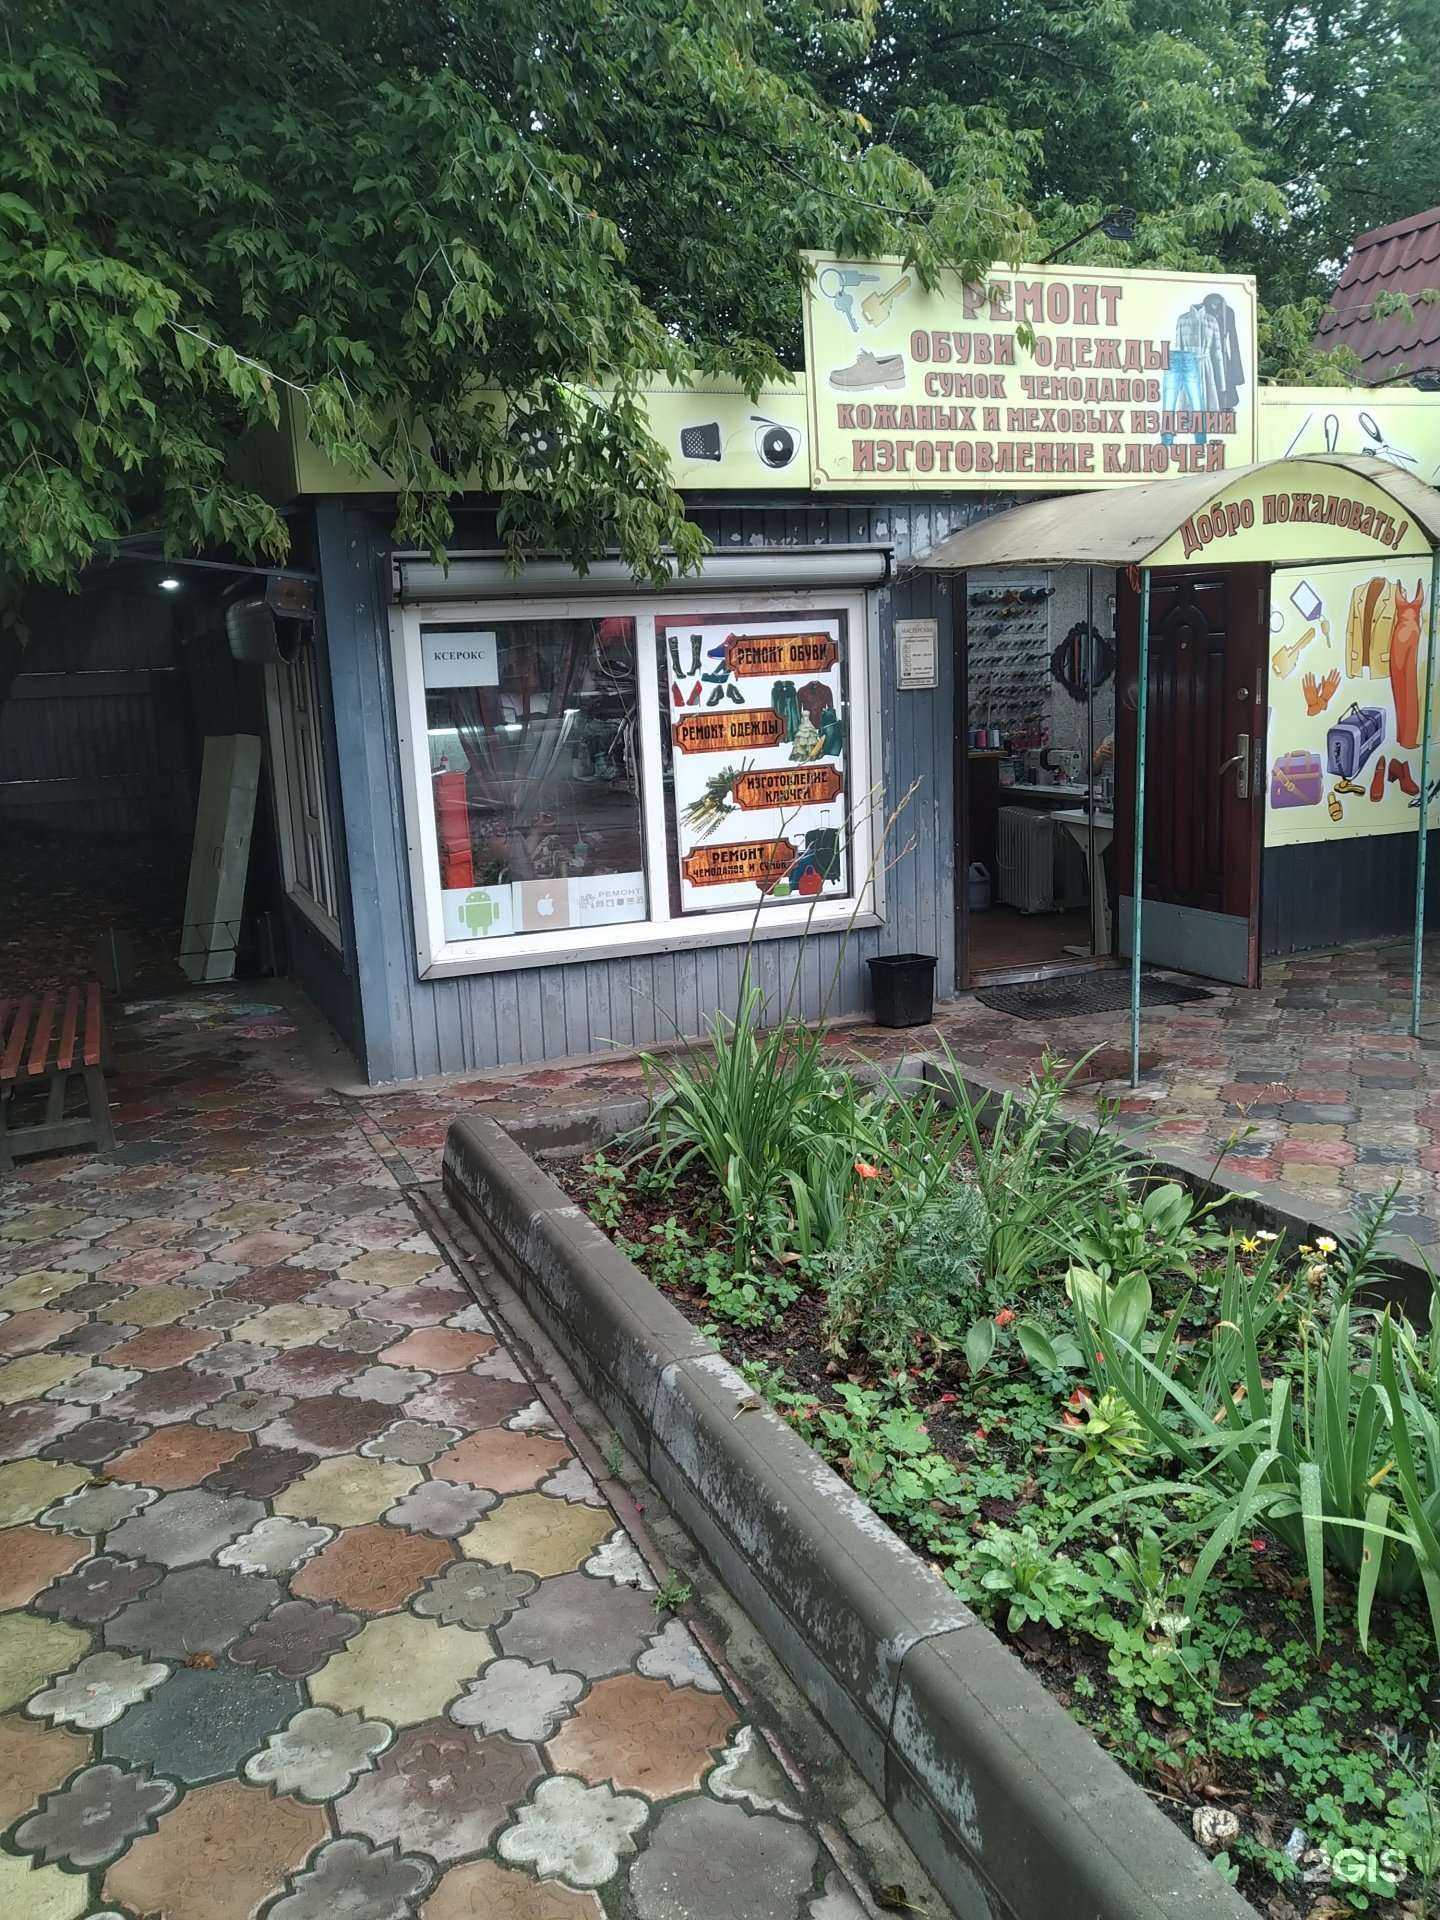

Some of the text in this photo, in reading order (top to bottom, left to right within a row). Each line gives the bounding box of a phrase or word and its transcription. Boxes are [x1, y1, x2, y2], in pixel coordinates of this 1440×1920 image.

[962, 279, 1123, 326] РЕМОНТ
[910, 329, 1171, 372] ОБУВИ ОДЕЖДЫ
[924, 372, 1161, 404] СУМОК ЧЕМОДАНОВ
[837, 403, 1237, 435] КОЖАНЫХ И МЕХОВЫХ ИЗДЕЛИЙ
[852, 438, 1226, 473] ИЗГОТОВЛЕНИЕ КЛЮЧЕЙ
[1179, 492, 1409, 560] Добро пожаловать!
[433, 650, 486, 662] КСЕРОКС
[737, 642, 828, 665] РЕМОНТ ОБУВИ
[682, 719, 779, 741] РЕМОНТ ОДЕЖДЫ
[693, 864, 745, 878] ЧЕМОДАНОВ
[712, 847, 765, 864] РЕМОНТ
